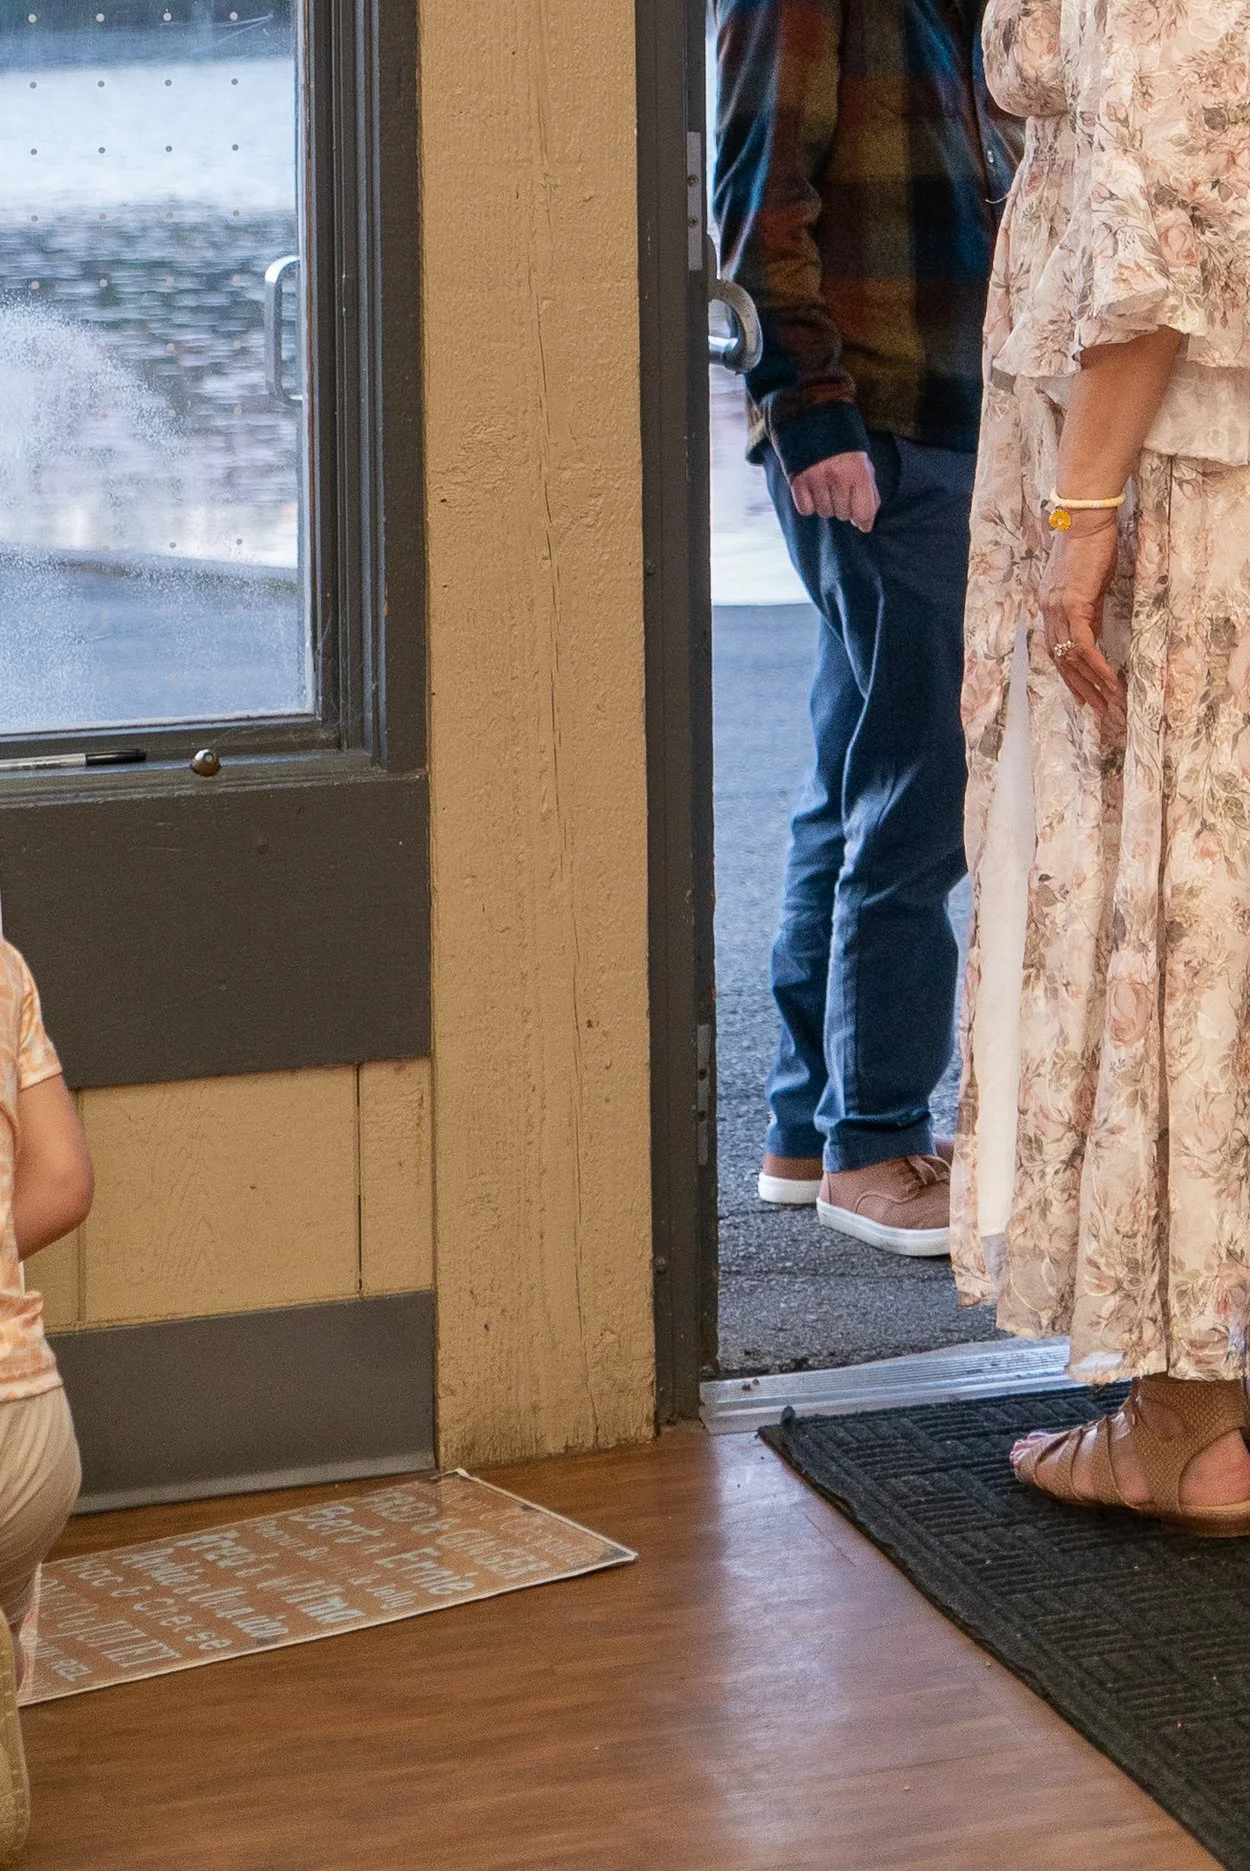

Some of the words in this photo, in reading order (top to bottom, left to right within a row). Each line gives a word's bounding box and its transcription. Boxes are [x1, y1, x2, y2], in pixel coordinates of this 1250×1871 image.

[176, 1530, 279, 1567] Fred
[258, 1572, 363, 1623] Wilma
[291, 1506, 384, 1543] Bert
[375, 1548, 477, 1594] Ernie
[360, 1492, 437, 1522] FRED
[411, 1518, 462, 1535] &
[437, 1529, 549, 1578] GINGER
[64, 1559, 124, 1587] Mac
[110, 1585, 153, 1597] &
[133, 1598, 232, 1649] Cheese
[173, 1583, 211, 1594] &
[348, 1574, 382, 1585] &
[366, 1584, 417, 1609] Jelly
